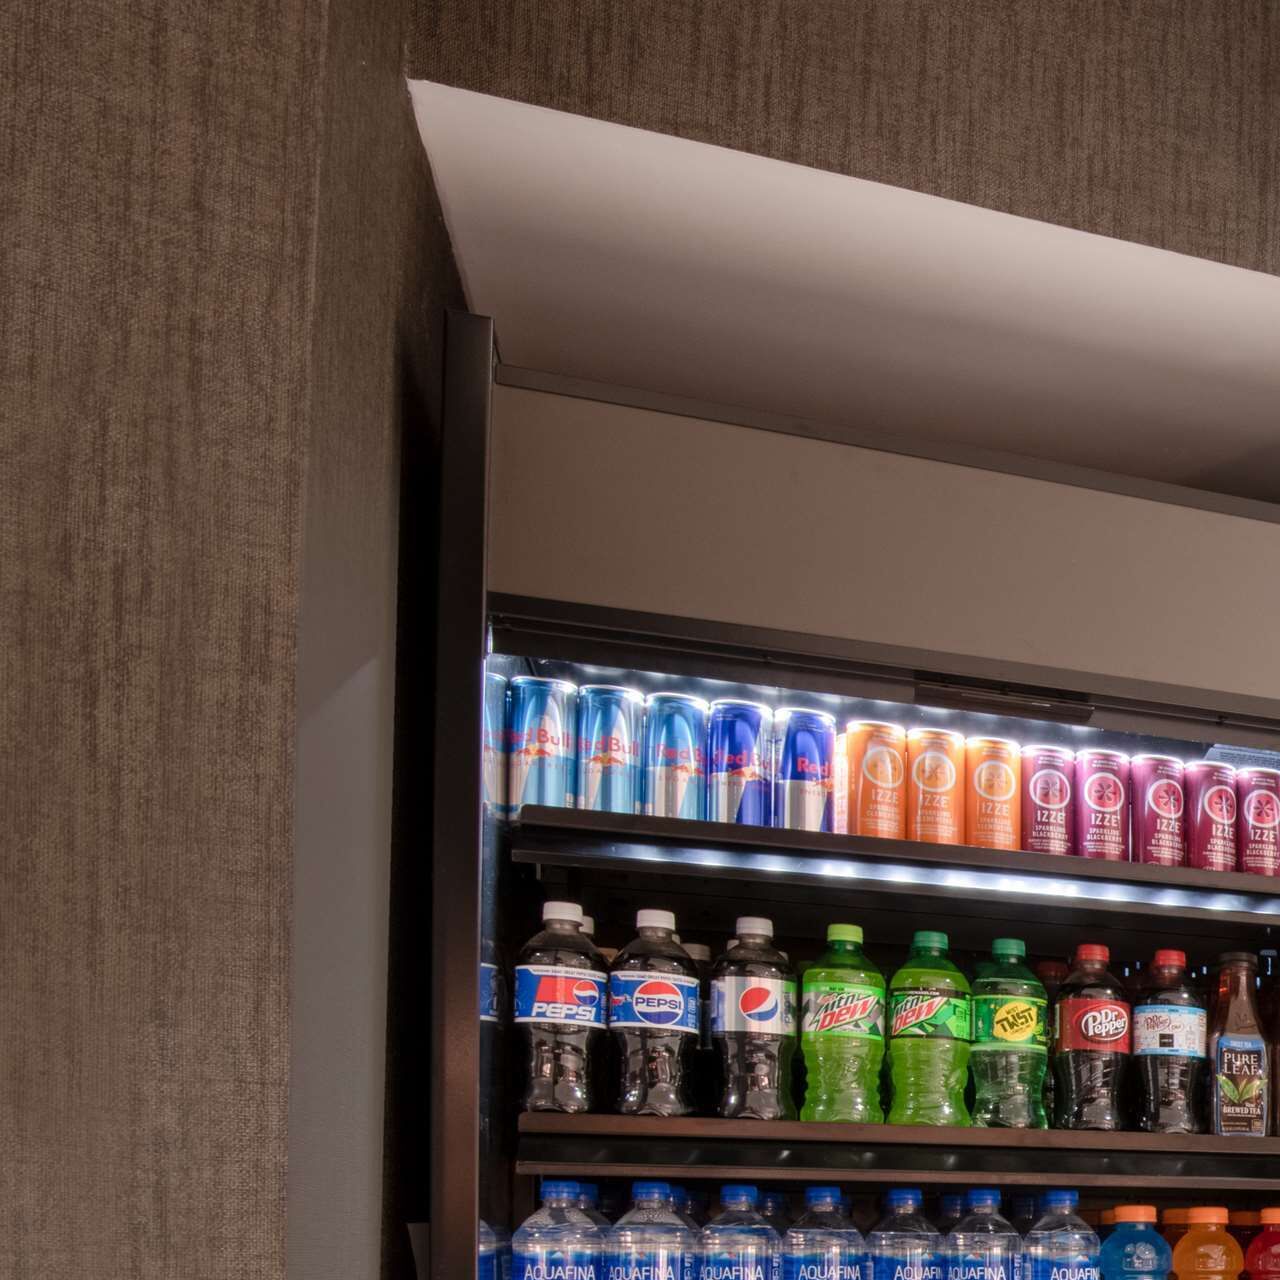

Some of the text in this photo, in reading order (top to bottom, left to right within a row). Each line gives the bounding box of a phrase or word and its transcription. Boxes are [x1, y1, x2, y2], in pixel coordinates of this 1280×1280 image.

[537, 728, 571, 748] Bull
[608, 736, 640, 757] Bull
[797, 757, 832, 776] Red
[1036, 810, 1065, 824] IZZE
[1090, 812, 1121, 827] IZZE
[1156, 819, 1182, 833] IZZE
[1211, 824, 1236, 839] IZZE
[1250, 829, 1277, 843] IZZE
[634, 996, 682, 1010] PEPSI
[530, 1002, 597, 1022] PEPSI
[1100, 1008, 1119, 1026] Dr
[1084, 1012, 1129, 1037] Pepper
[1223, 1053, 1259, 1066] PURE
